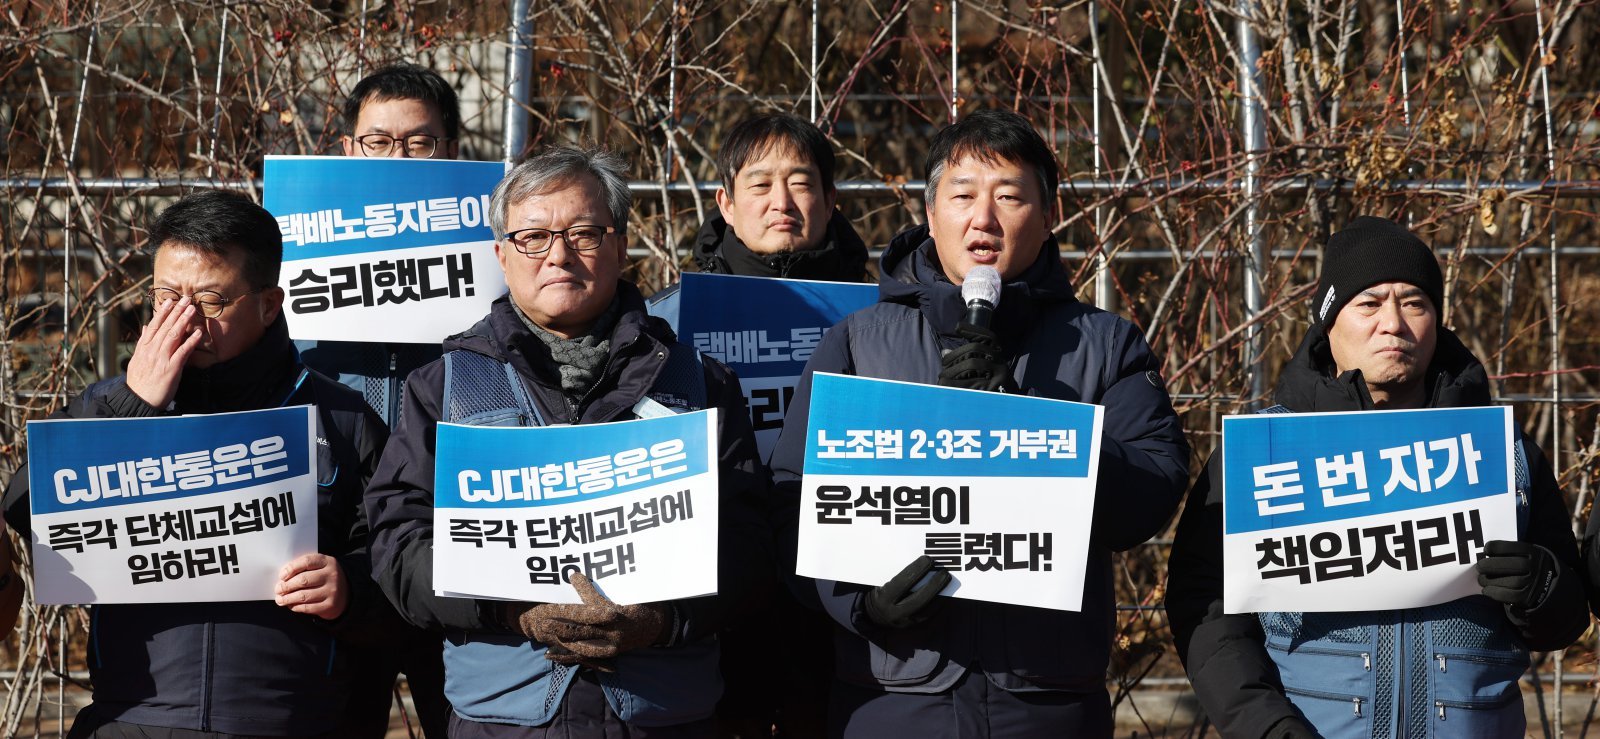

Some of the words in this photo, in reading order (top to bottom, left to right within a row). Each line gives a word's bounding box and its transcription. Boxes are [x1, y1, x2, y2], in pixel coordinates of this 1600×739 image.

[275, 194, 491, 247] 택배노동자들이
[289, 252, 475, 315] 승리했다!
[53, 435, 288, 505] CJ대한통운은
[457, 438, 688, 503] CJ대한통운은
[817, 429, 903, 459] 노조법
[989, 429, 1077, 459] 거부권
[1252, 461, 1305, 517] 돈
[1315, 450, 1371, 508] 번
[1379, 432, 1482, 497] 자가
[48, 518, 119, 553] 즉각
[125, 491, 297, 548] 단체교섭에
[449, 518, 518, 549] 즉각
[525, 489, 694, 548] 단체교섭에
[815, 485, 970, 525] 윤석열이
[127, 544, 240, 585] 임하라!
[526, 542, 636, 585] 임하라!
[924, 532, 1053, 572] 틀렸다!
[1255, 509, 1486, 585] 책임져라!
